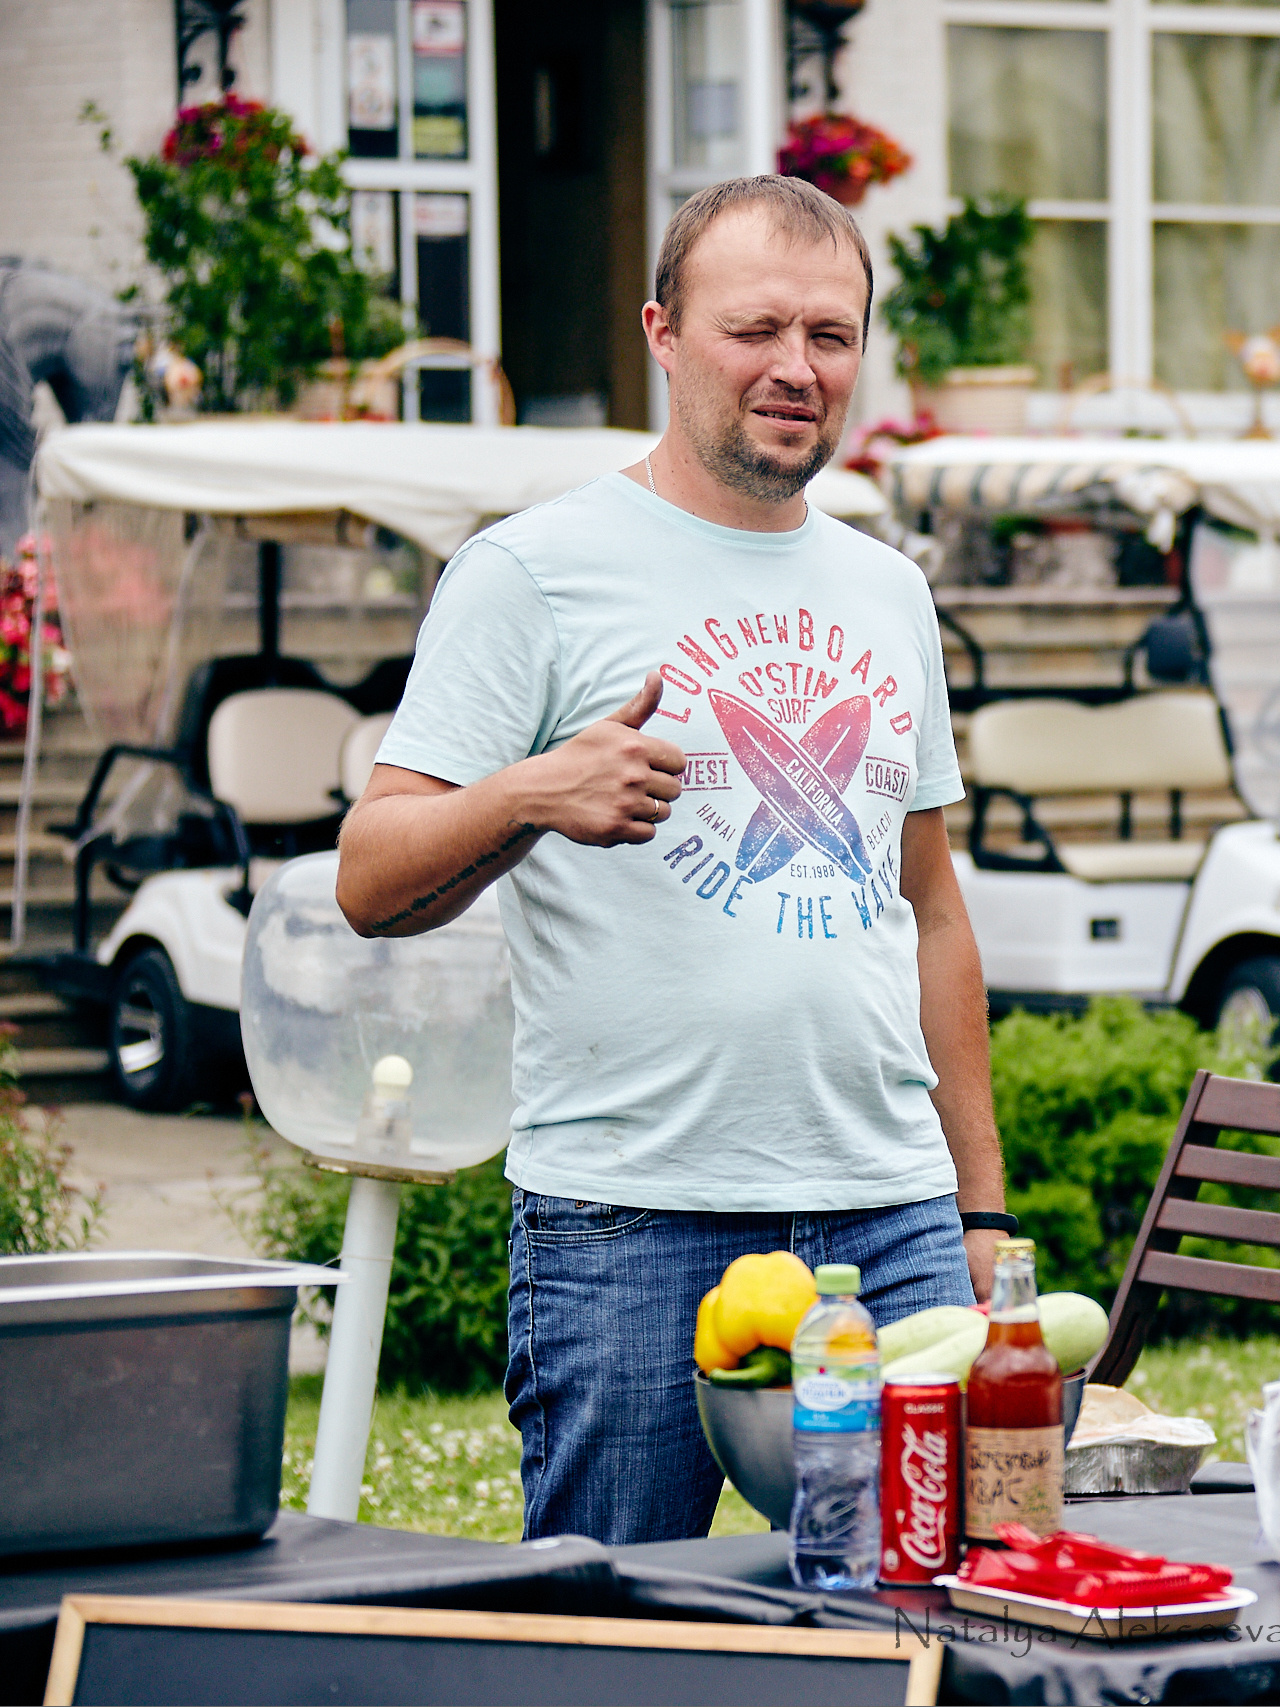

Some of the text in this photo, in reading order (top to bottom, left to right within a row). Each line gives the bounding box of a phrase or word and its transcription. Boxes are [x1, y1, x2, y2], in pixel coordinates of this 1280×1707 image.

[654, 608, 914, 736] LONG NEW BOARD
[738, 661, 839, 699] O'STIN
[766, 698, 817, 725] SURF
[677, 759, 729, 785] WEST
[865, 761, 907, 796] COAST
[785, 758, 845, 826] CALIFORNIA
[696, 802, 737, 843] HAWAI
[867, 810, 893, 851] BEACH
[663, 834, 899, 940] RIDE THE WAVE
[789, 862, 836, 880] EST.1988
